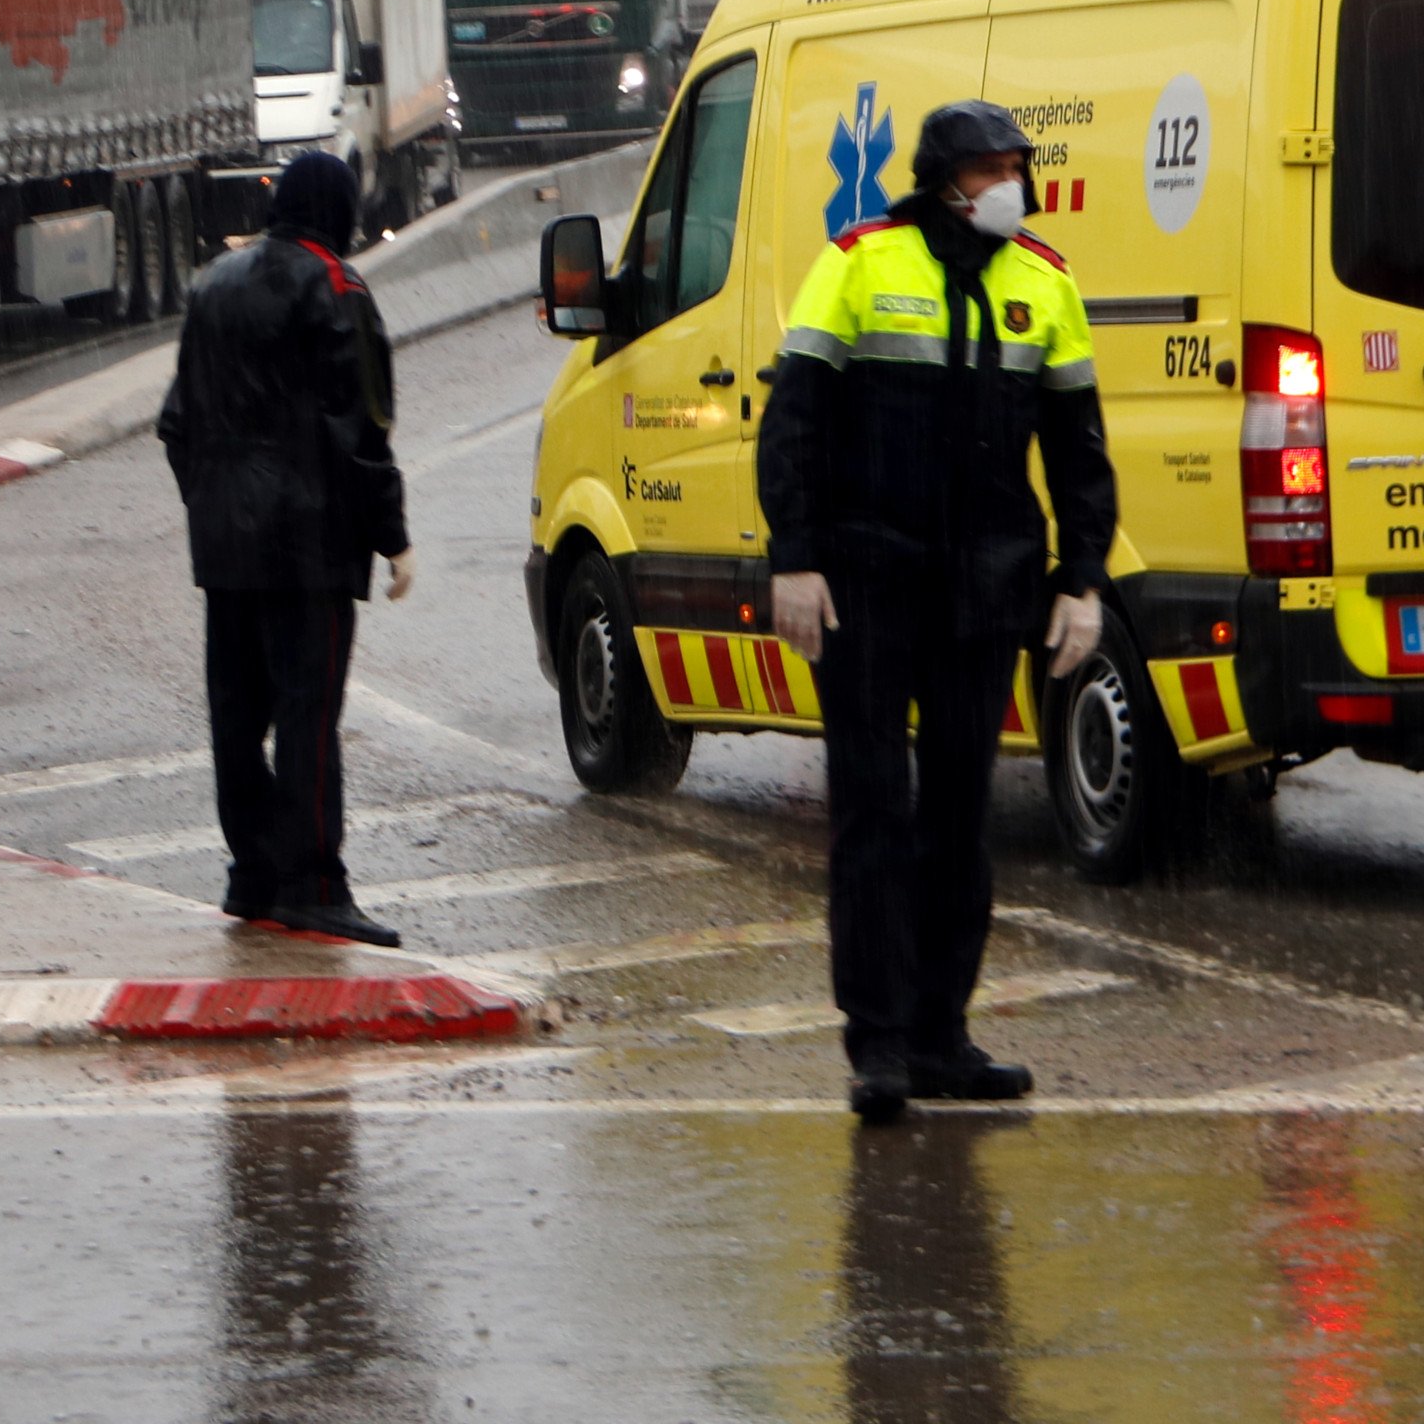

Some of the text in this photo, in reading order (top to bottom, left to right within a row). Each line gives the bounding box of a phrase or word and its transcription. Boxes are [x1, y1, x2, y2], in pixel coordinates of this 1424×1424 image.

[1154, 114, 1200, 168] 112
[1165, 335, 1211, 377] 6724
[640, 478, 682, 502] CatSalut
